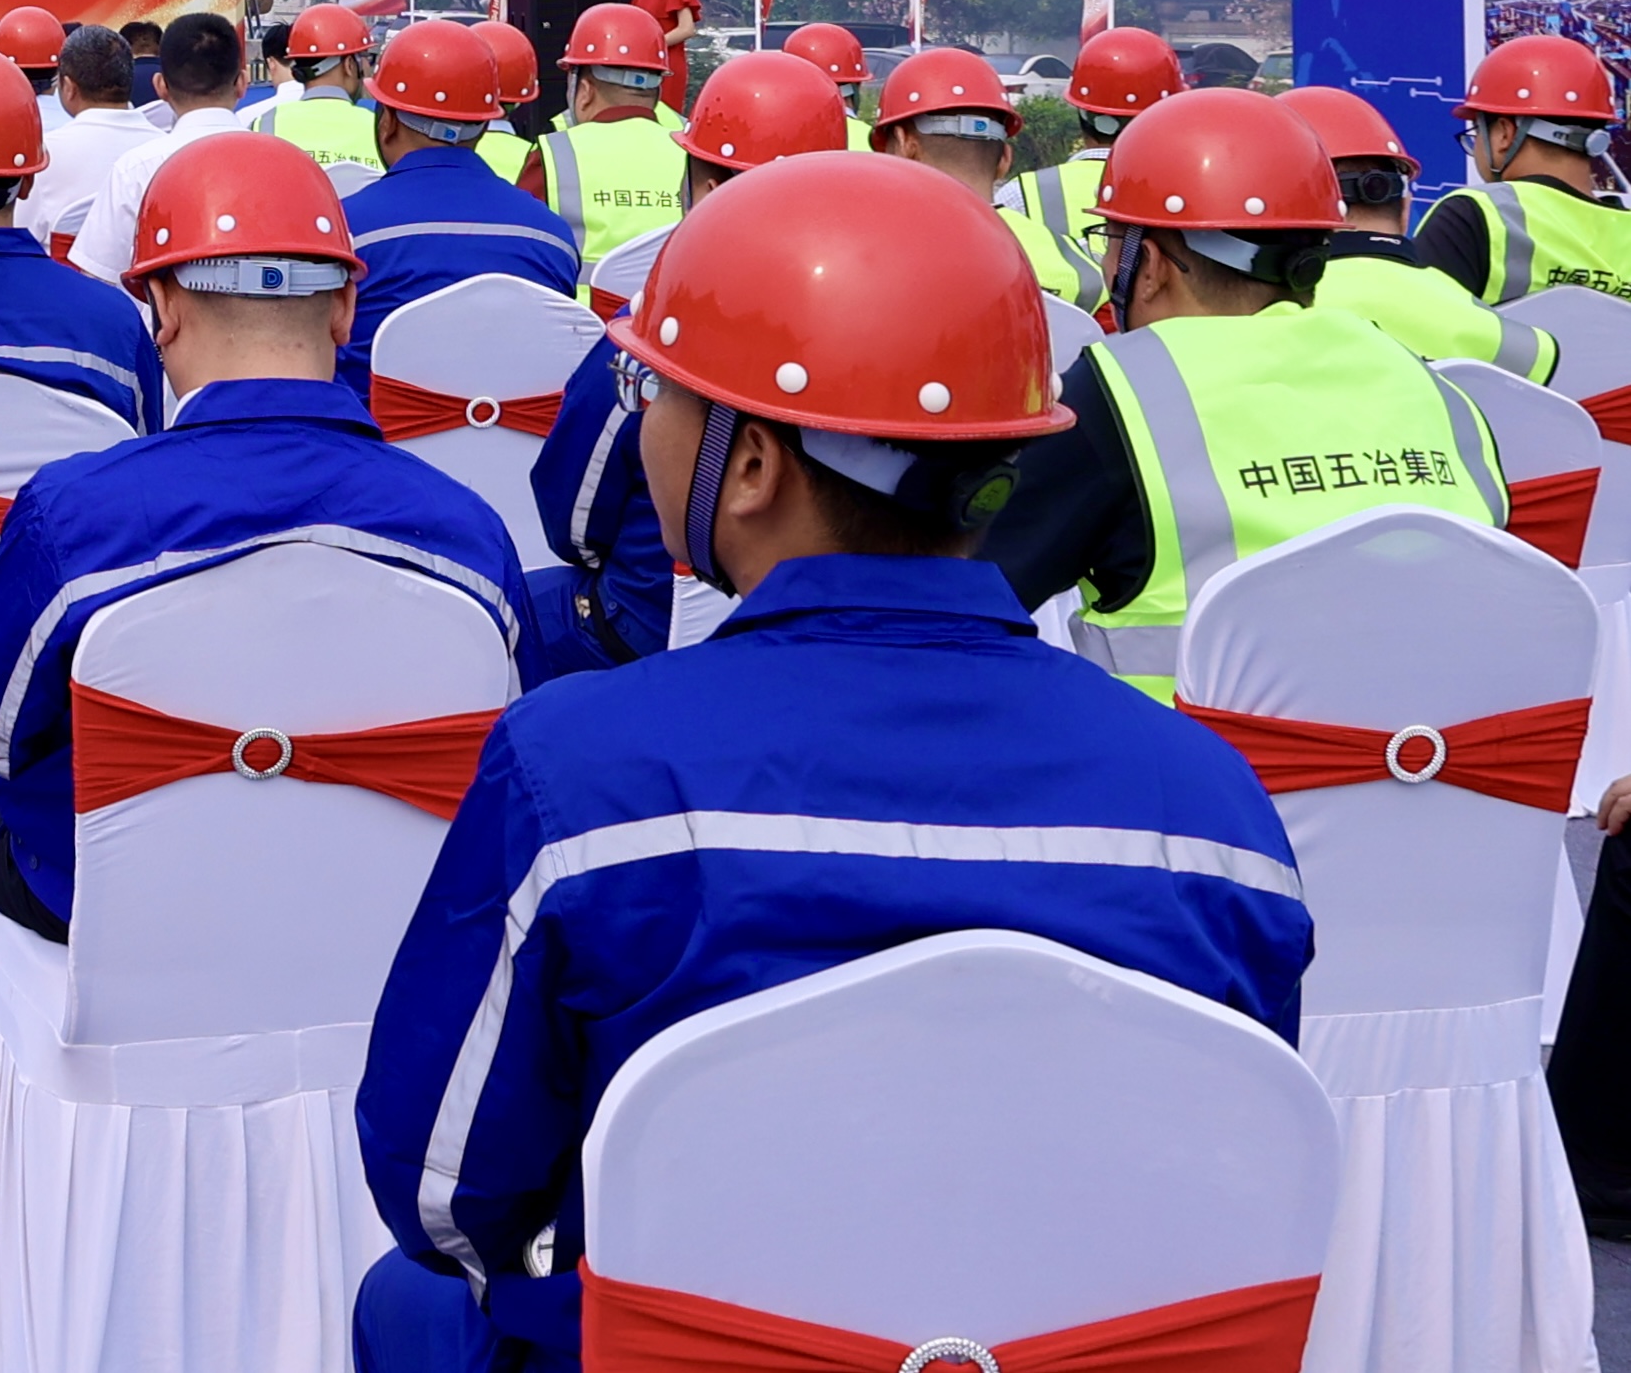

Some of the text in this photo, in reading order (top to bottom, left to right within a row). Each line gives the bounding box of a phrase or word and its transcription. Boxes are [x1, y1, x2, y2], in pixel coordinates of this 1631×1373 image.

[1239, 448, 1455, 501] 中国五冶集团
